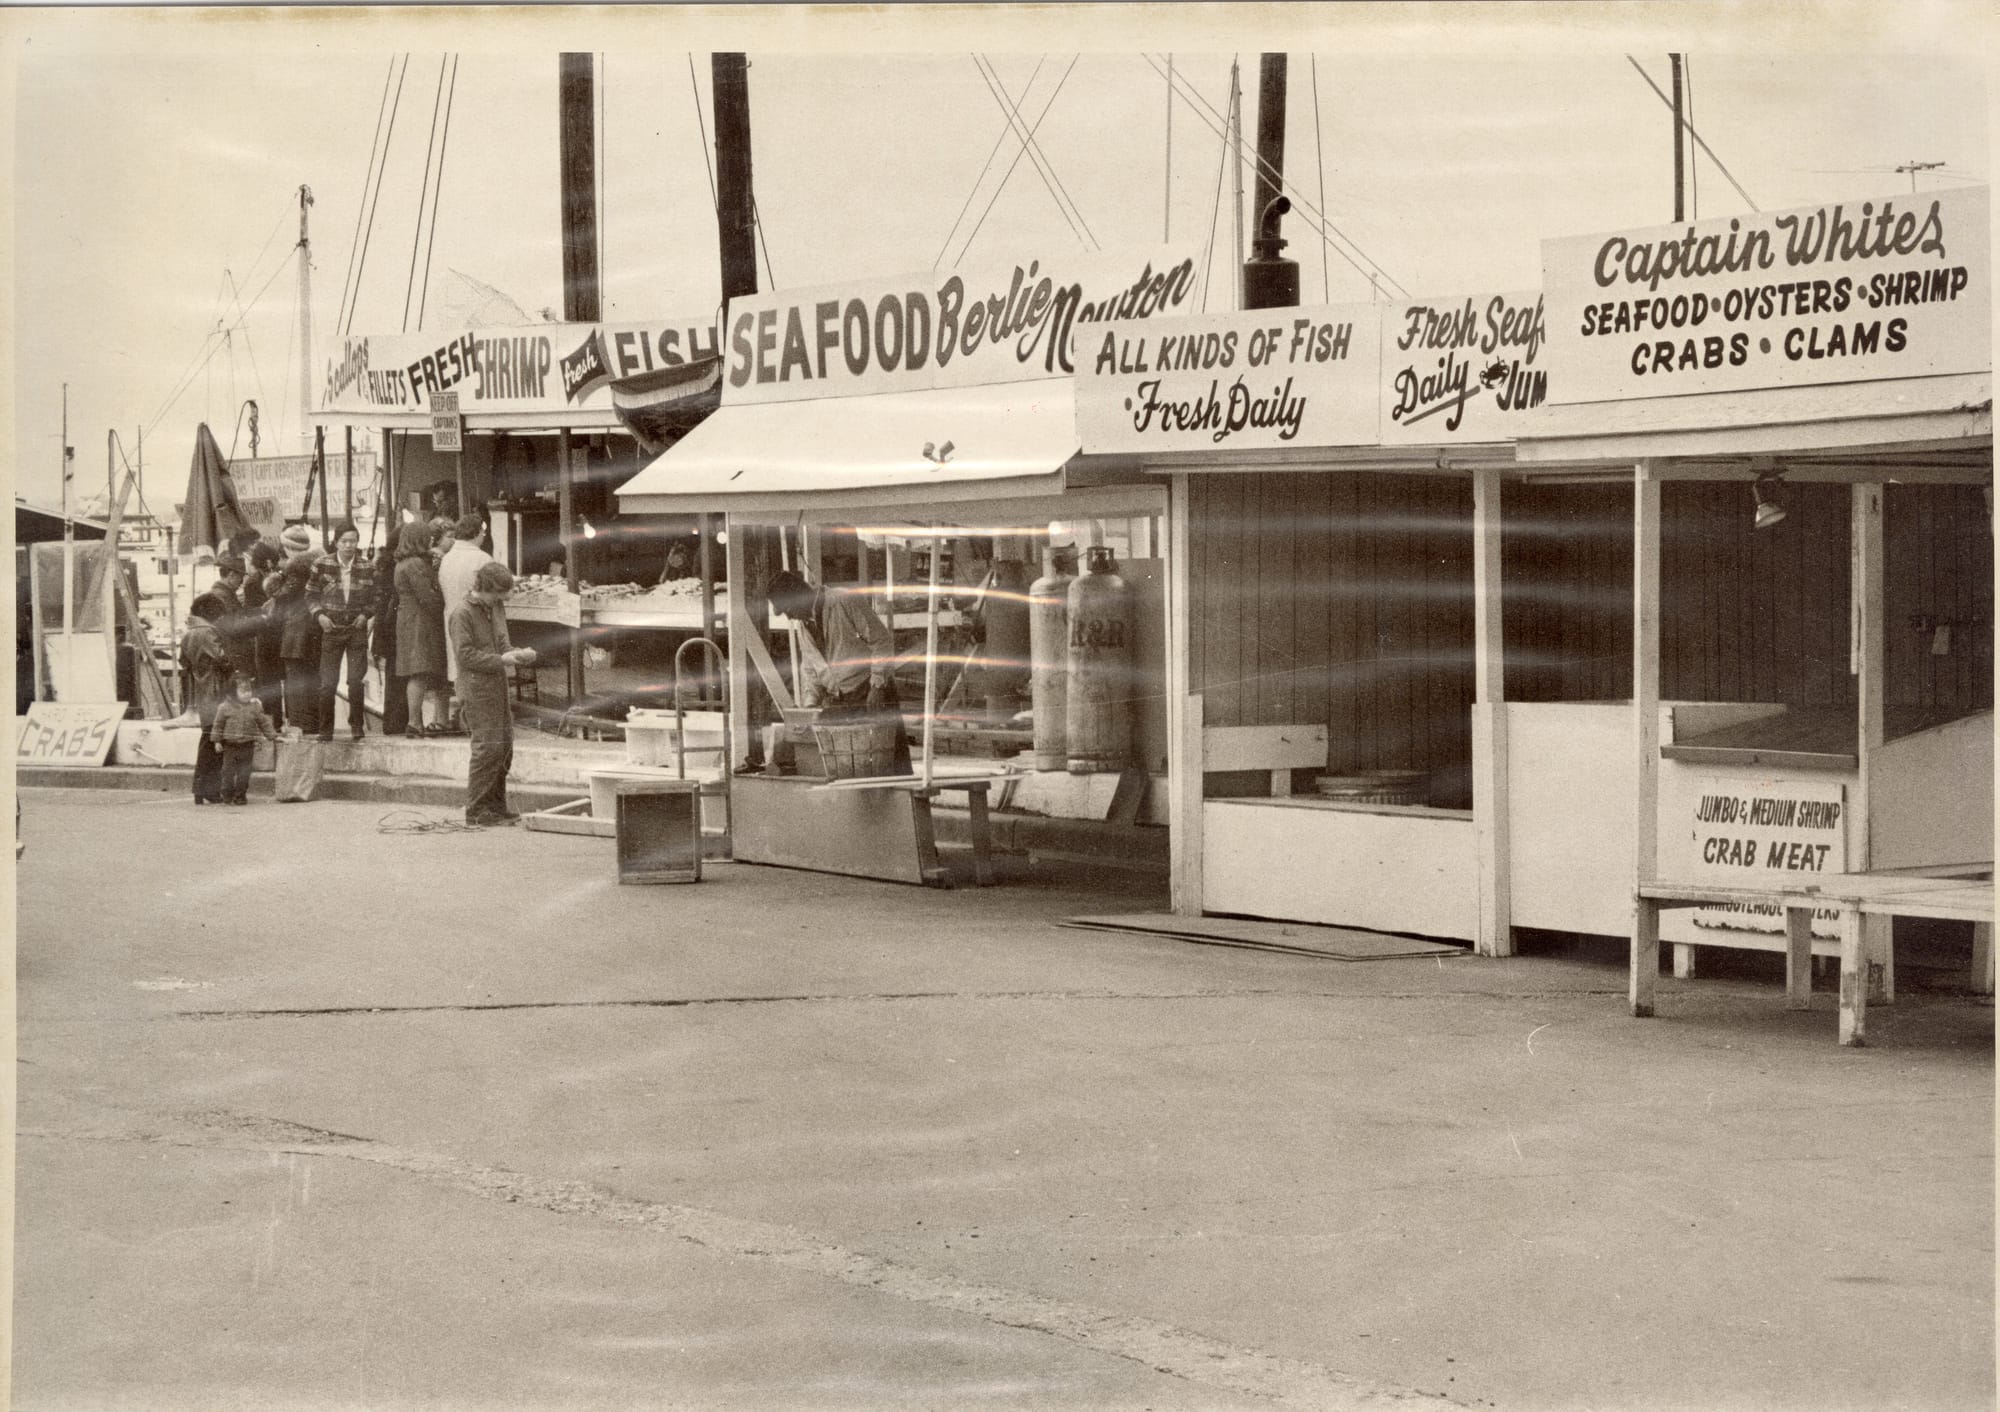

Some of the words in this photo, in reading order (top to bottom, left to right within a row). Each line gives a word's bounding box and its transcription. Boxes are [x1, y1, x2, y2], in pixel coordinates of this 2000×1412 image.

[1594, 217, 1775, 291] Captain
[1776, 200, 1946, 263] Whites
[729, 290, 932, 388] SEAFOOD
[936, 259, 1053, 368] Berlie
[1397, 297, 1479, 351] Fresh
[1480, 292, 1546, 366] Seaf
[1581, 292, 1708, 336] SEAFOOD
[1723, 277, 1852, 322] OYSTERS
[1868, 266, 1968, 308] SHRIMP
[368, 369, 407, 405] FILLETS
[407, 332, 478, 405] FRESH
[475, 336, 551, 401] SHRIMP
[564, 347, 598, 393] fresh
[614, 327, 718, 379] FISH
[1095, 330, 1148, 375] ALL
[1156, 331, 1238, 372] KINDS
[1247, 327, 1283, 368] OF
[1289, 319, 1353, 363] FISH
[1631, 332, 1749, 376] CRABS
[1784, 318, 1908, 361] CLAMS
[1133, 379, 1222, 432] Fresh
[1213, 373, 1307, 443] Daily
[1392, 351, 1470, 432] Daily
[17, 718, 111, 757] CRABS
[1696, 795, 1739, 823] JUMBO
[1739, 799, 1748, 825] &
[1750, 797, 1797, 828] MEDIUM
[1797, 800, 1841, 830] SHRIMP
[1703, 837, 1758, 868] CRAB
[1766, 840, 1831, 872] MEAT
